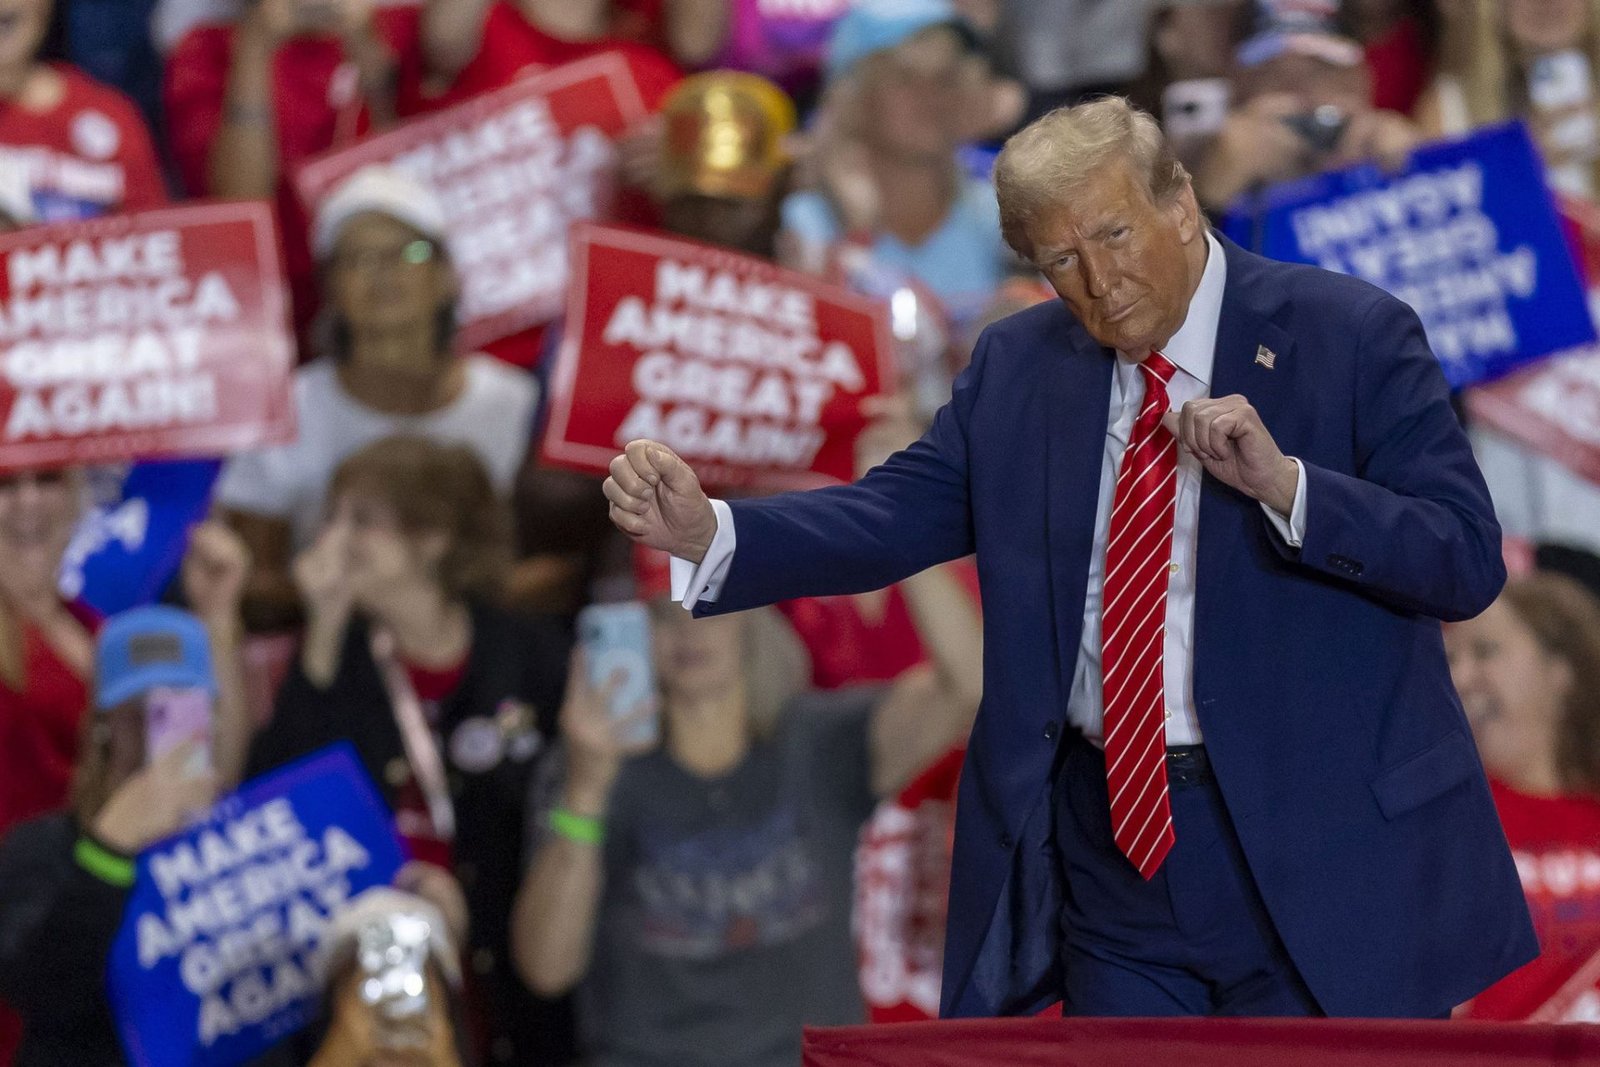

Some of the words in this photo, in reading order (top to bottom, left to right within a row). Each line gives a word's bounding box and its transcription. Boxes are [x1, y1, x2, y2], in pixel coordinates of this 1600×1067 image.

[8, 229, 183, 287] MAKE
[654, 257, 814, 336] MAKE
[0, 271, 240, 337] MERICA
[4, 325, 202, 386] GREAT
[601, 295, 867, 396] AMERICA
[5, 372, 217, 440] AGAIN!
[631, 350, 836, 427] GREAT
[149, 797, 307, 899] MAKE
[136, 824, 372, 970] AMERICA
